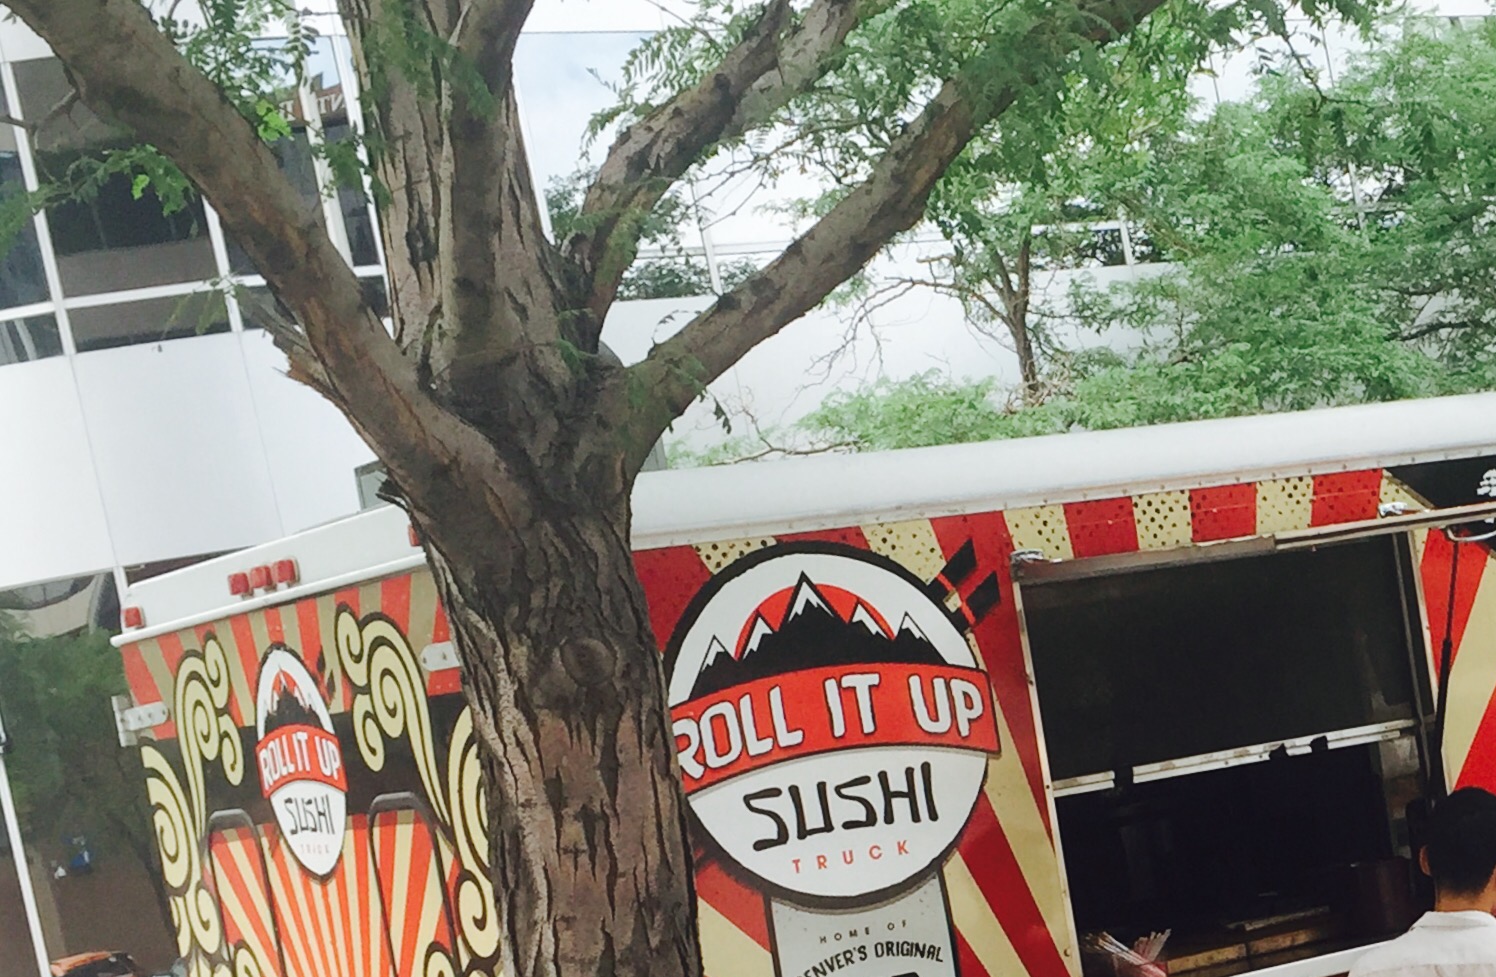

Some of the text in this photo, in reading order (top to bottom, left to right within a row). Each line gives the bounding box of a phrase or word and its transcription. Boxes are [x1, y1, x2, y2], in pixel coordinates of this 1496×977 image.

[672, 673, 984, 780] ROLL IT UP
[259, 731, 341, 791] ROLL IT UP
[284, 794, 335, 835] SUSHI
[742, 761, 939, 852] SUSHI
[792, 839, 910, 874] TRUCK
[819, 919, 908, 944] HOME OF
[874, 941, 944, 963] ORIGINAL
